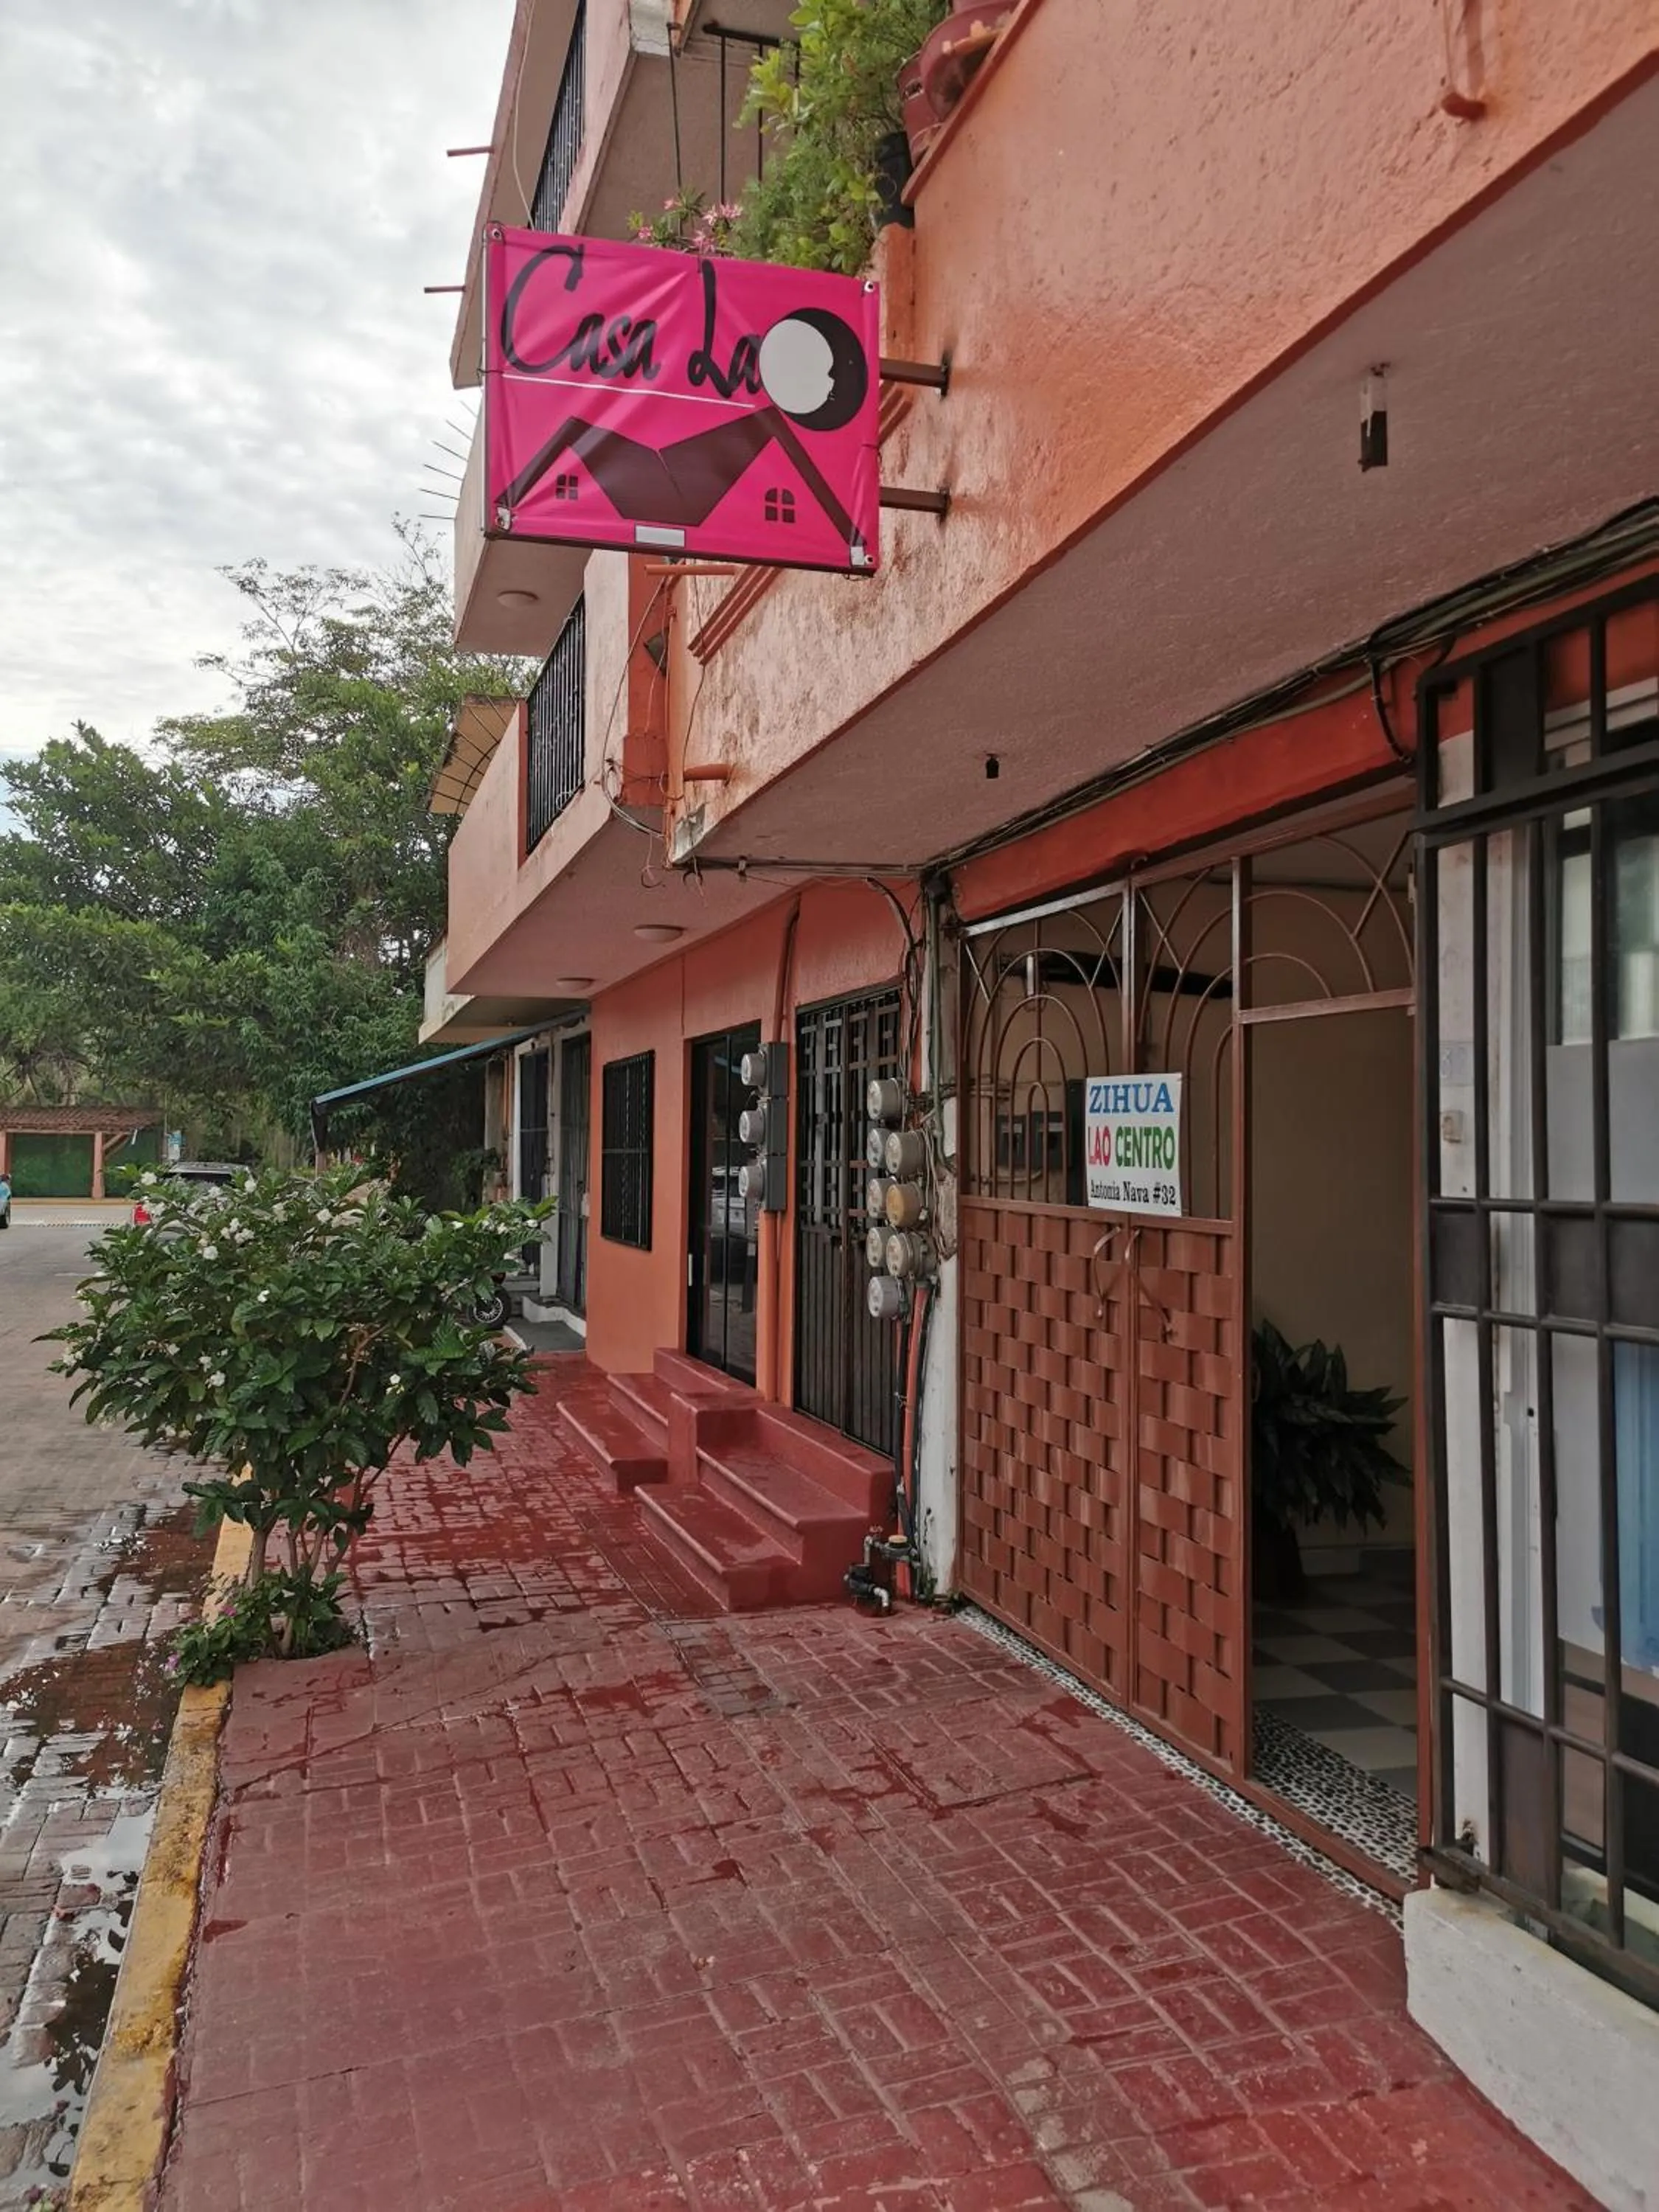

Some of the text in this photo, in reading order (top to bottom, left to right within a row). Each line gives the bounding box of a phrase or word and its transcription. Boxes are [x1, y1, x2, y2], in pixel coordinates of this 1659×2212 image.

[501, 244, 661, 380] Casa
[1089, 1082, 1175, 1113] ZIHUA
[1088, 1125, 1176, 1170] LAO CENTRO
[1091, 1180, 1176, 1206] Antonia Nava #32
